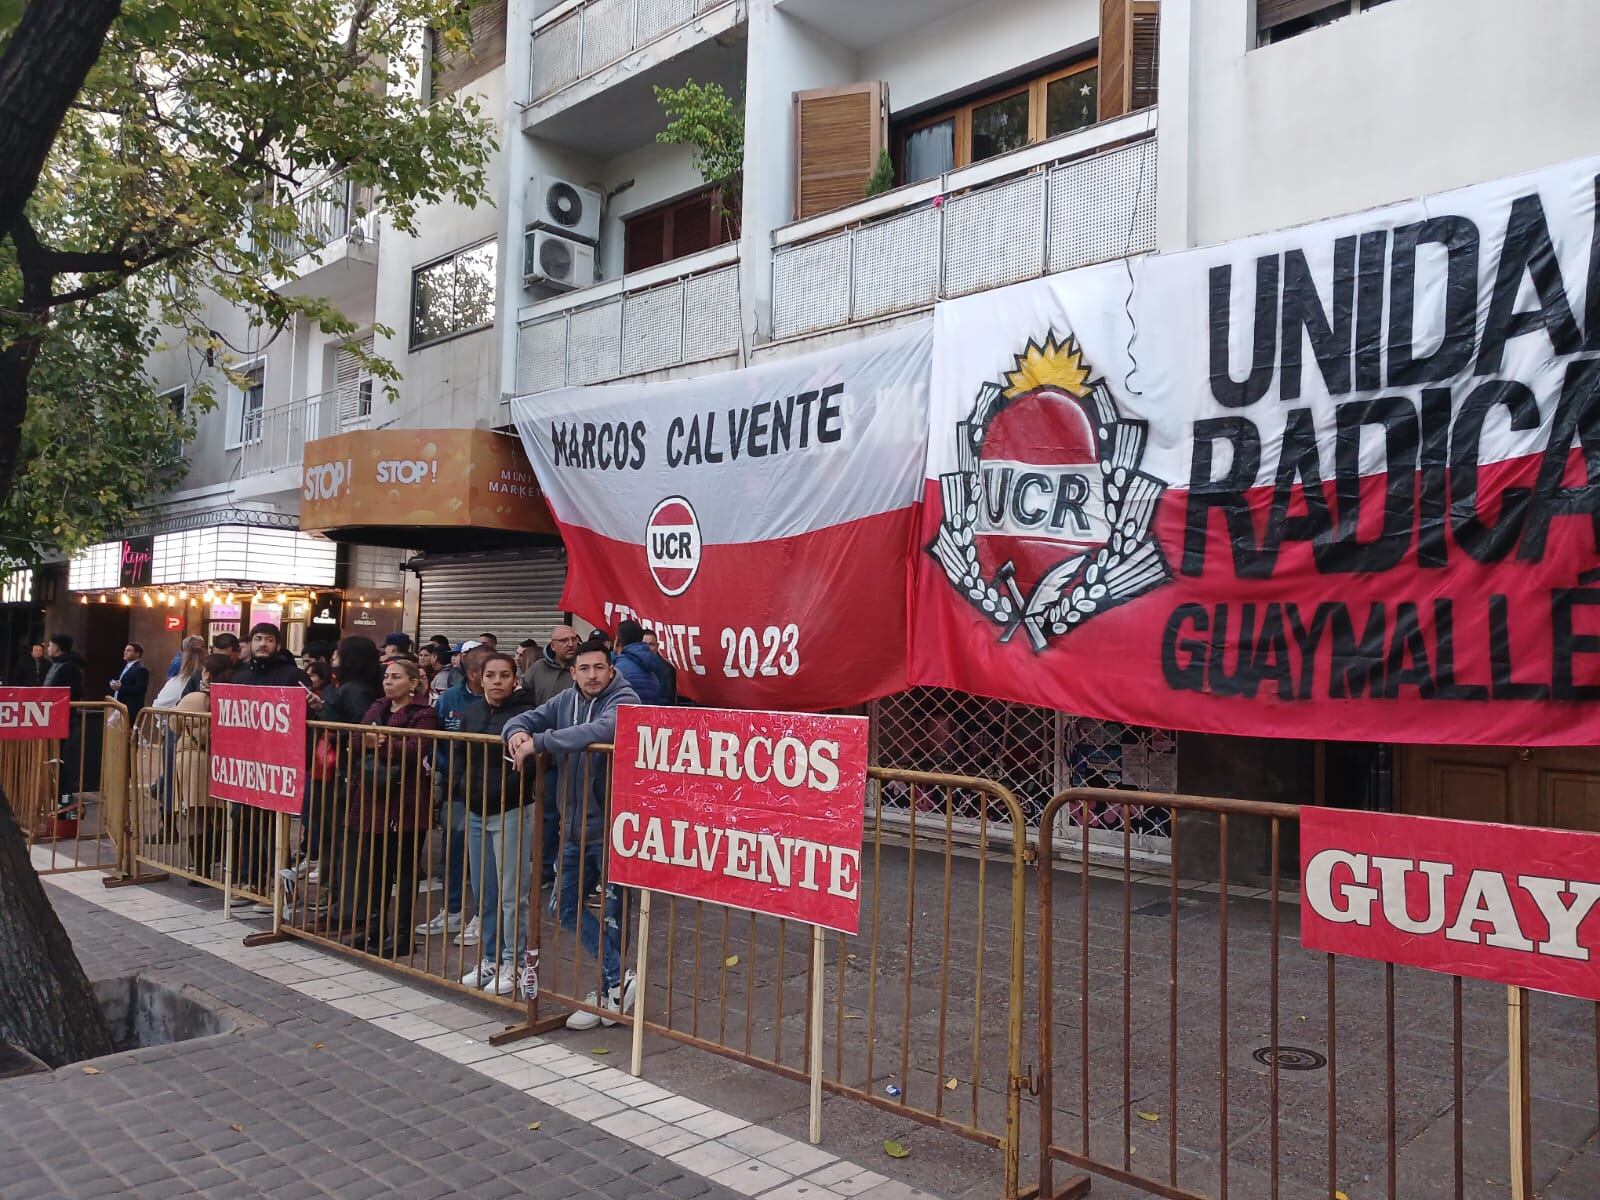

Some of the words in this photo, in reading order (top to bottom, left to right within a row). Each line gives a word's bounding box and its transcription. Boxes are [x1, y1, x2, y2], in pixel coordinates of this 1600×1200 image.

[1208, 174, 1600, 409] UNIDA
[551, 420, 646, 470] MARCOS
[666, 382, 845, 466] CALVENTE
[489, 481, 541, 497] MARKET
[501, 469, 532, 482] MINI
[981, 467, 1093, 536] UCR
[652, 532, 692, 560] UCR
[721, 623, 800, 678] 2023
[0, 701, 53, 727] EN
[218, 698, 290, 734] MARCOS
[211, 754, 297, 798] CALVENTE
[635, 726, 839, 792] MARCOS
[611, 811, 861, 900] CALVENTE
[1305, 848, 1600, 961] GUAY
